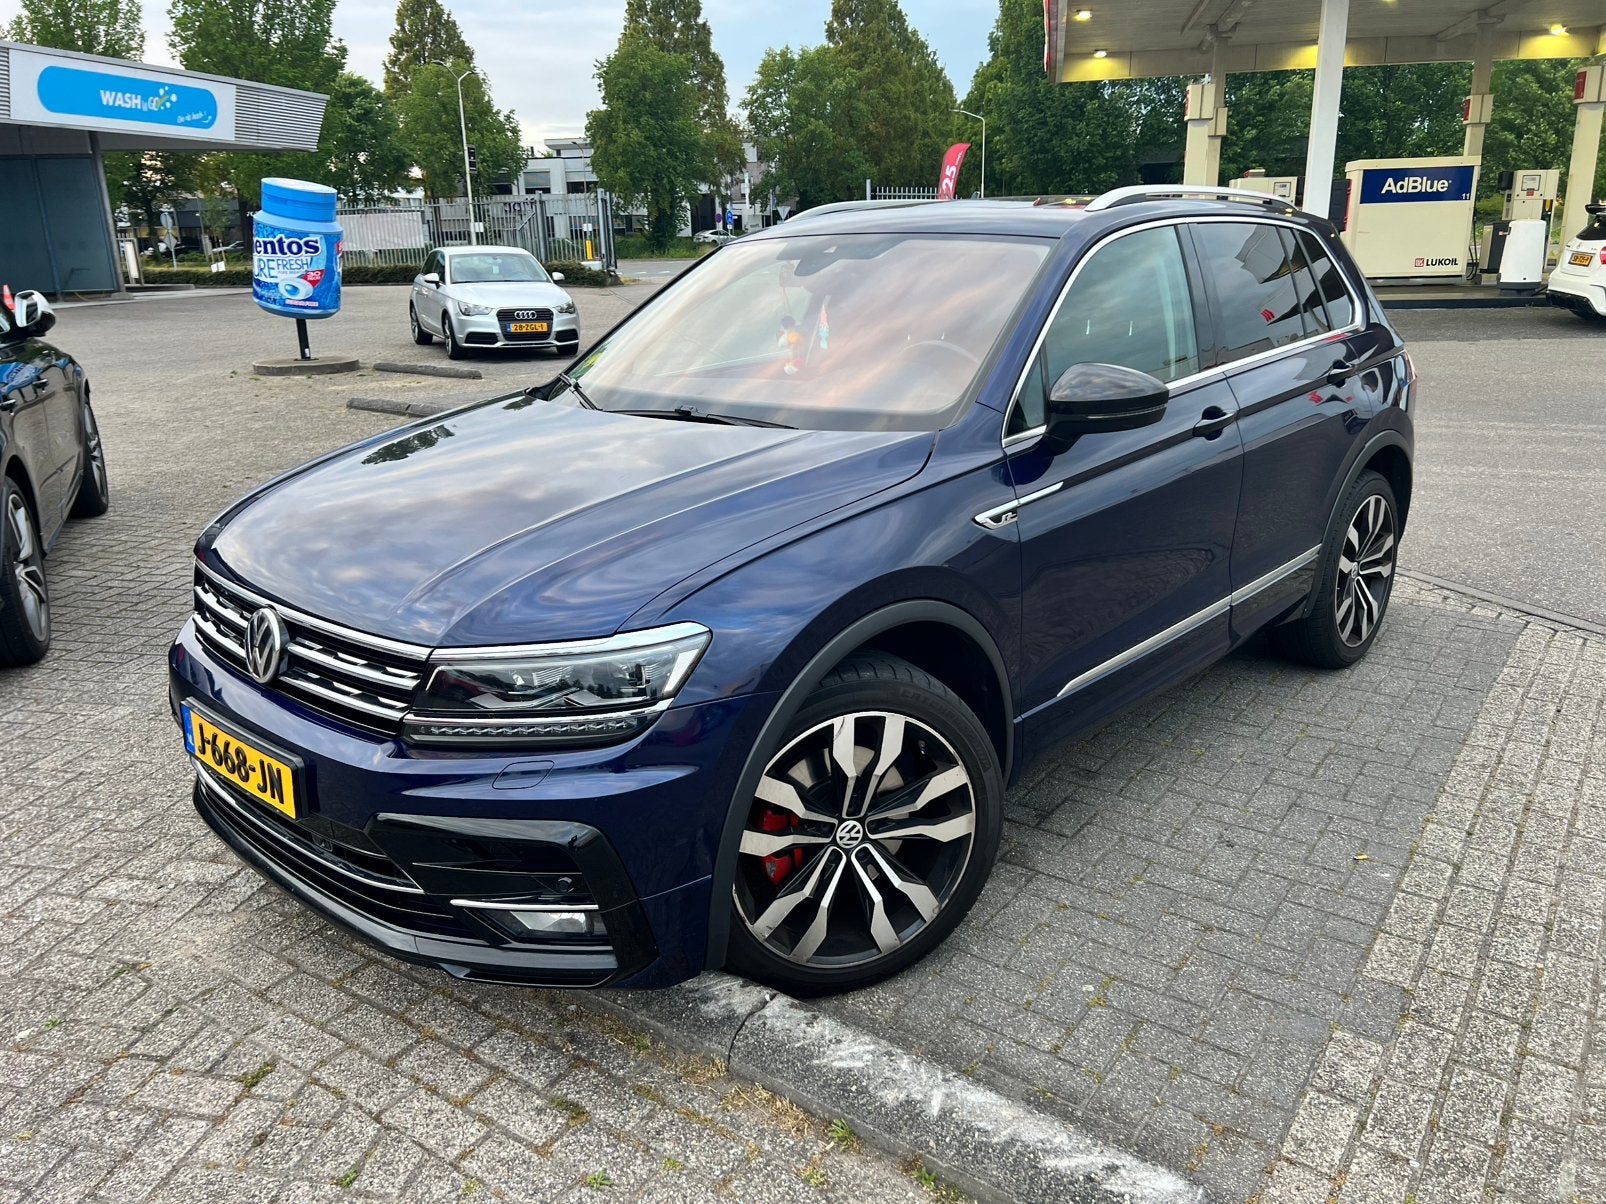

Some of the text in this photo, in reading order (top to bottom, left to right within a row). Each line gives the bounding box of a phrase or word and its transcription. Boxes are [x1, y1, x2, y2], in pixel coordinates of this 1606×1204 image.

[100, 90, 142, 109] WASH
[1381, 177, 1449, 194] AdBlue
[254, 235, 321, 256] entos
[276, 258, 309, 271] FRESH
[1425, 257, 1459, 267] LUKOIL
[513, 323, 544, 331] 28-ZGL-1
[198, 722, 285, 805] J-668-JN
